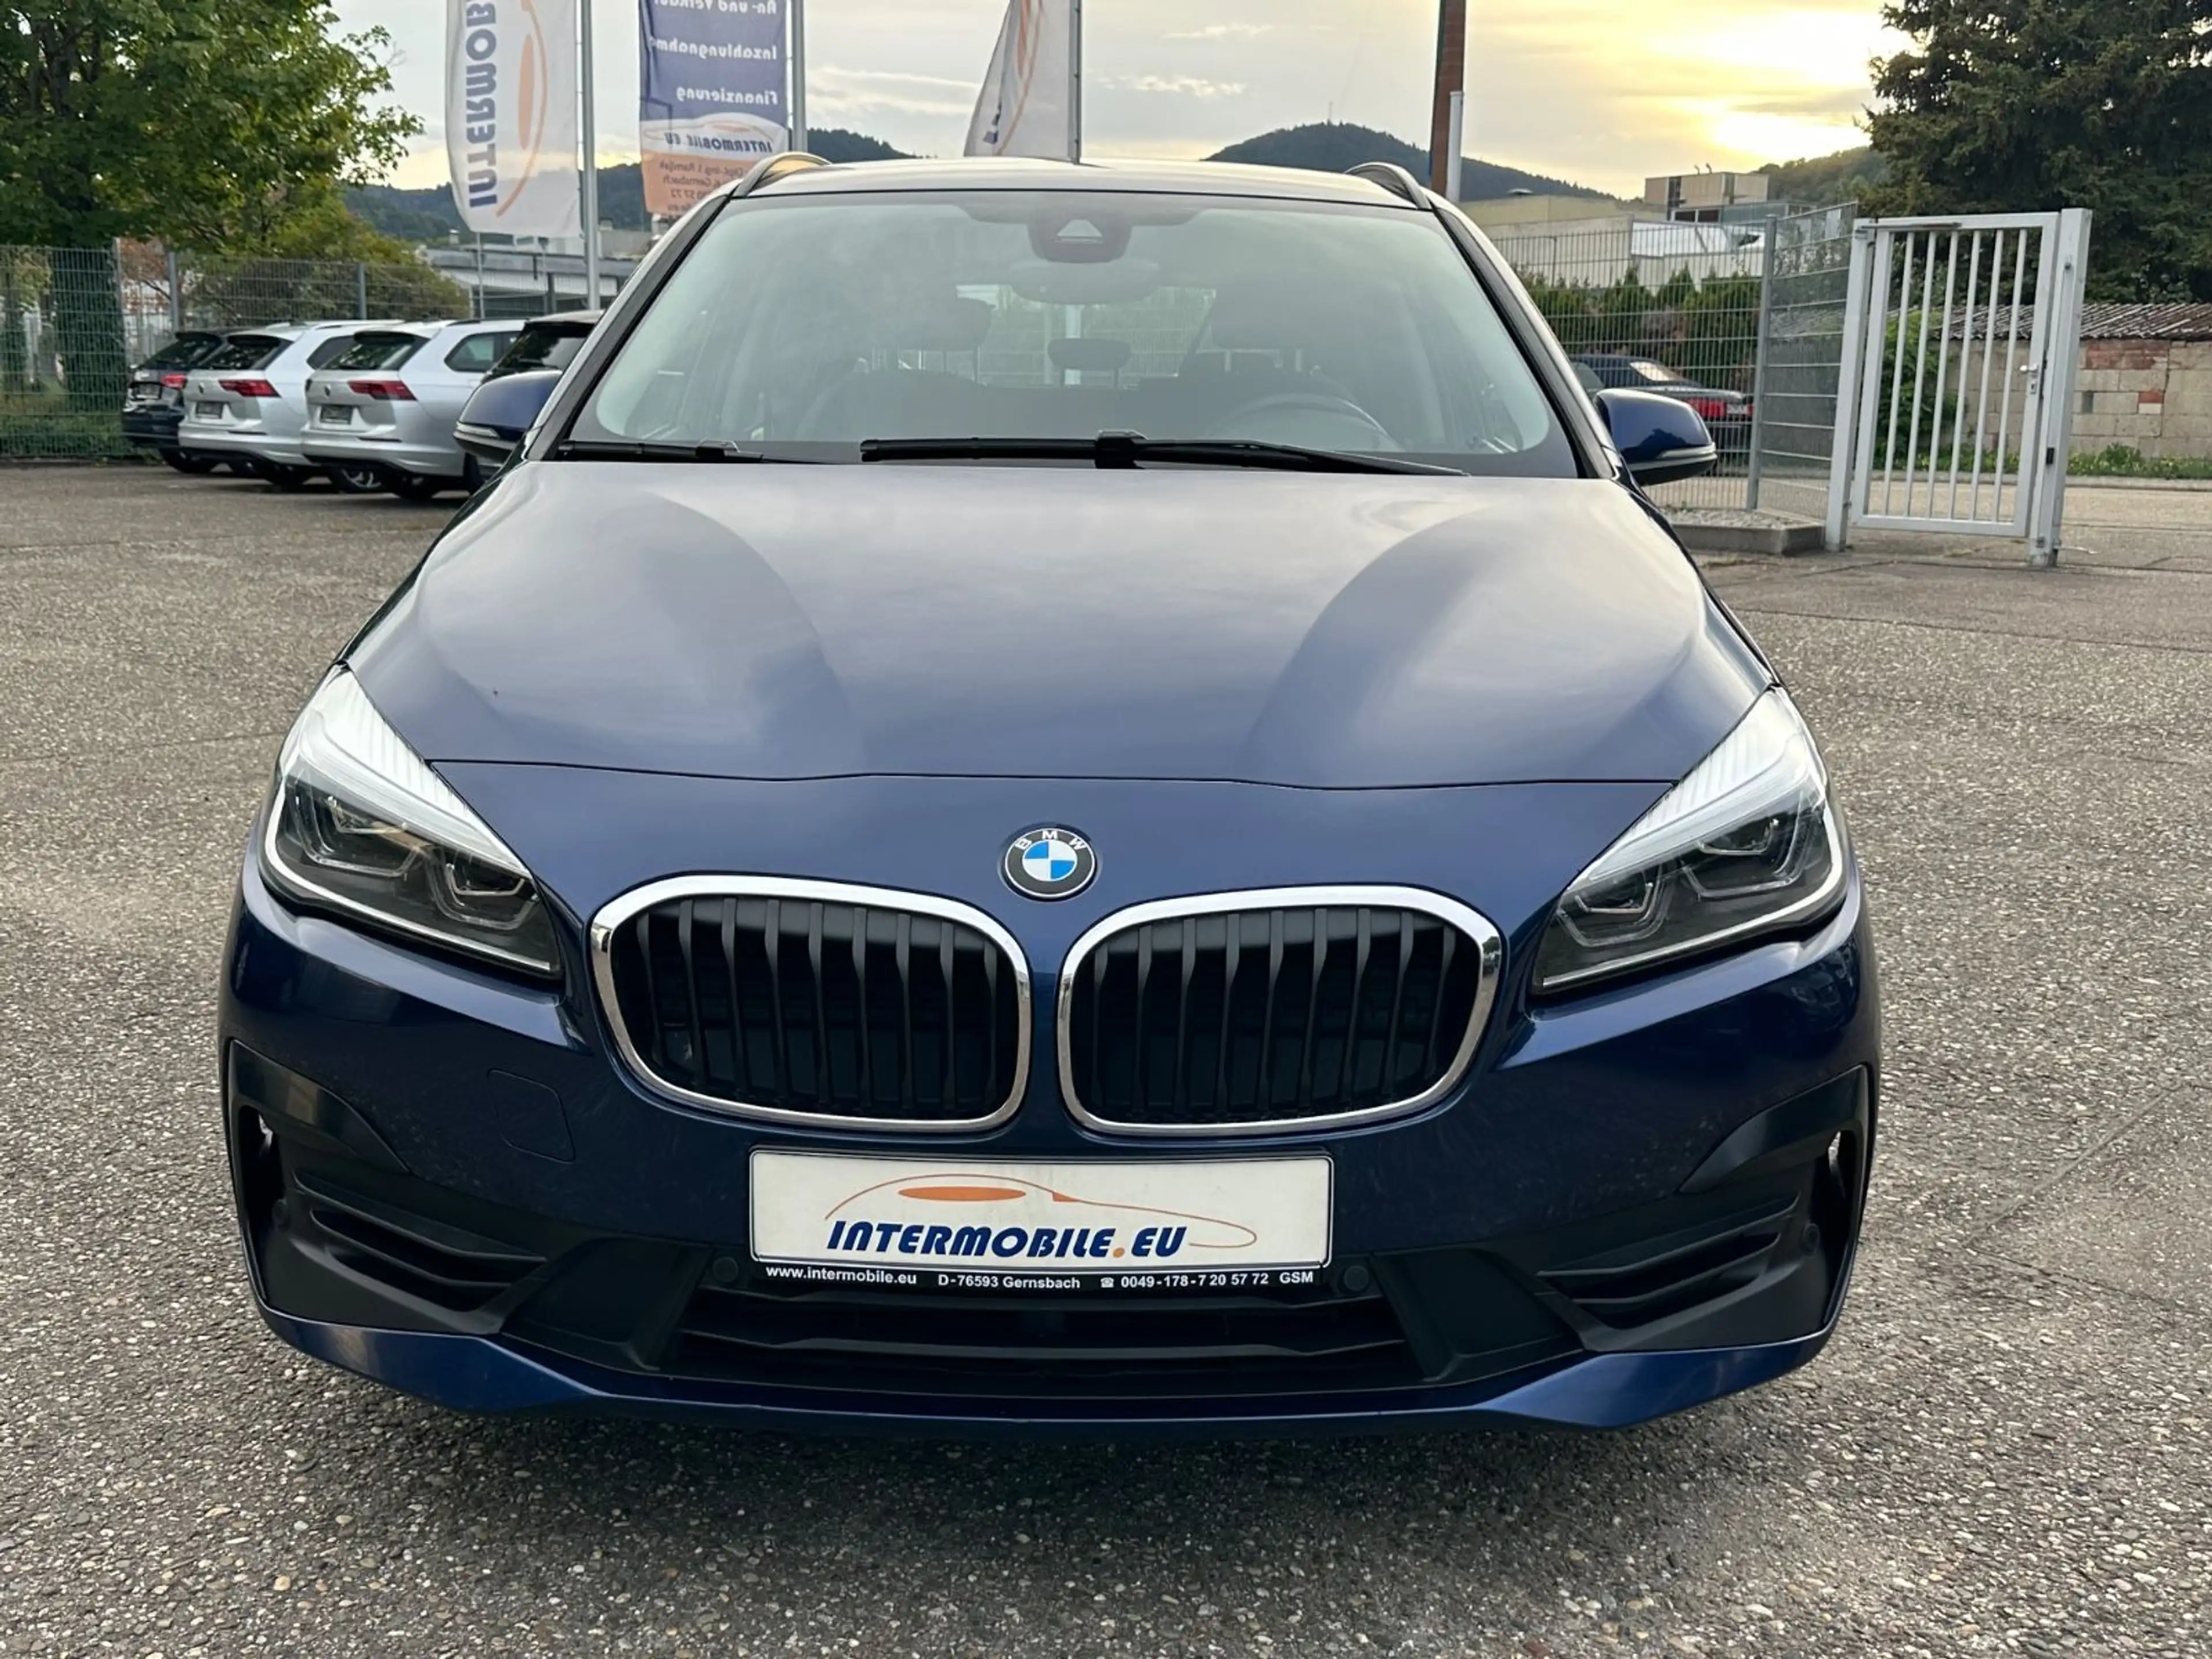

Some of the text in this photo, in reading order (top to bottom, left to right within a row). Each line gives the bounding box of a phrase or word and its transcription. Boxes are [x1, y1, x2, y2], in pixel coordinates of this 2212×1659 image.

[1014, 830, 1086, 850] BMW
[827, 1220, 1187, 1258] INTERMOBILE.EU
[766, 1266, 917, 1285] www.intermobile.eu
[938, 1274, 999, 1287] D-76593
[1003, 1277, 1081, 1289] Gernsbach
[1231, 1272, 1248, 1286] 57
[1252, 1272, 1269, 1285] 72
[1279, 1271, 1314, 1283] GSM
